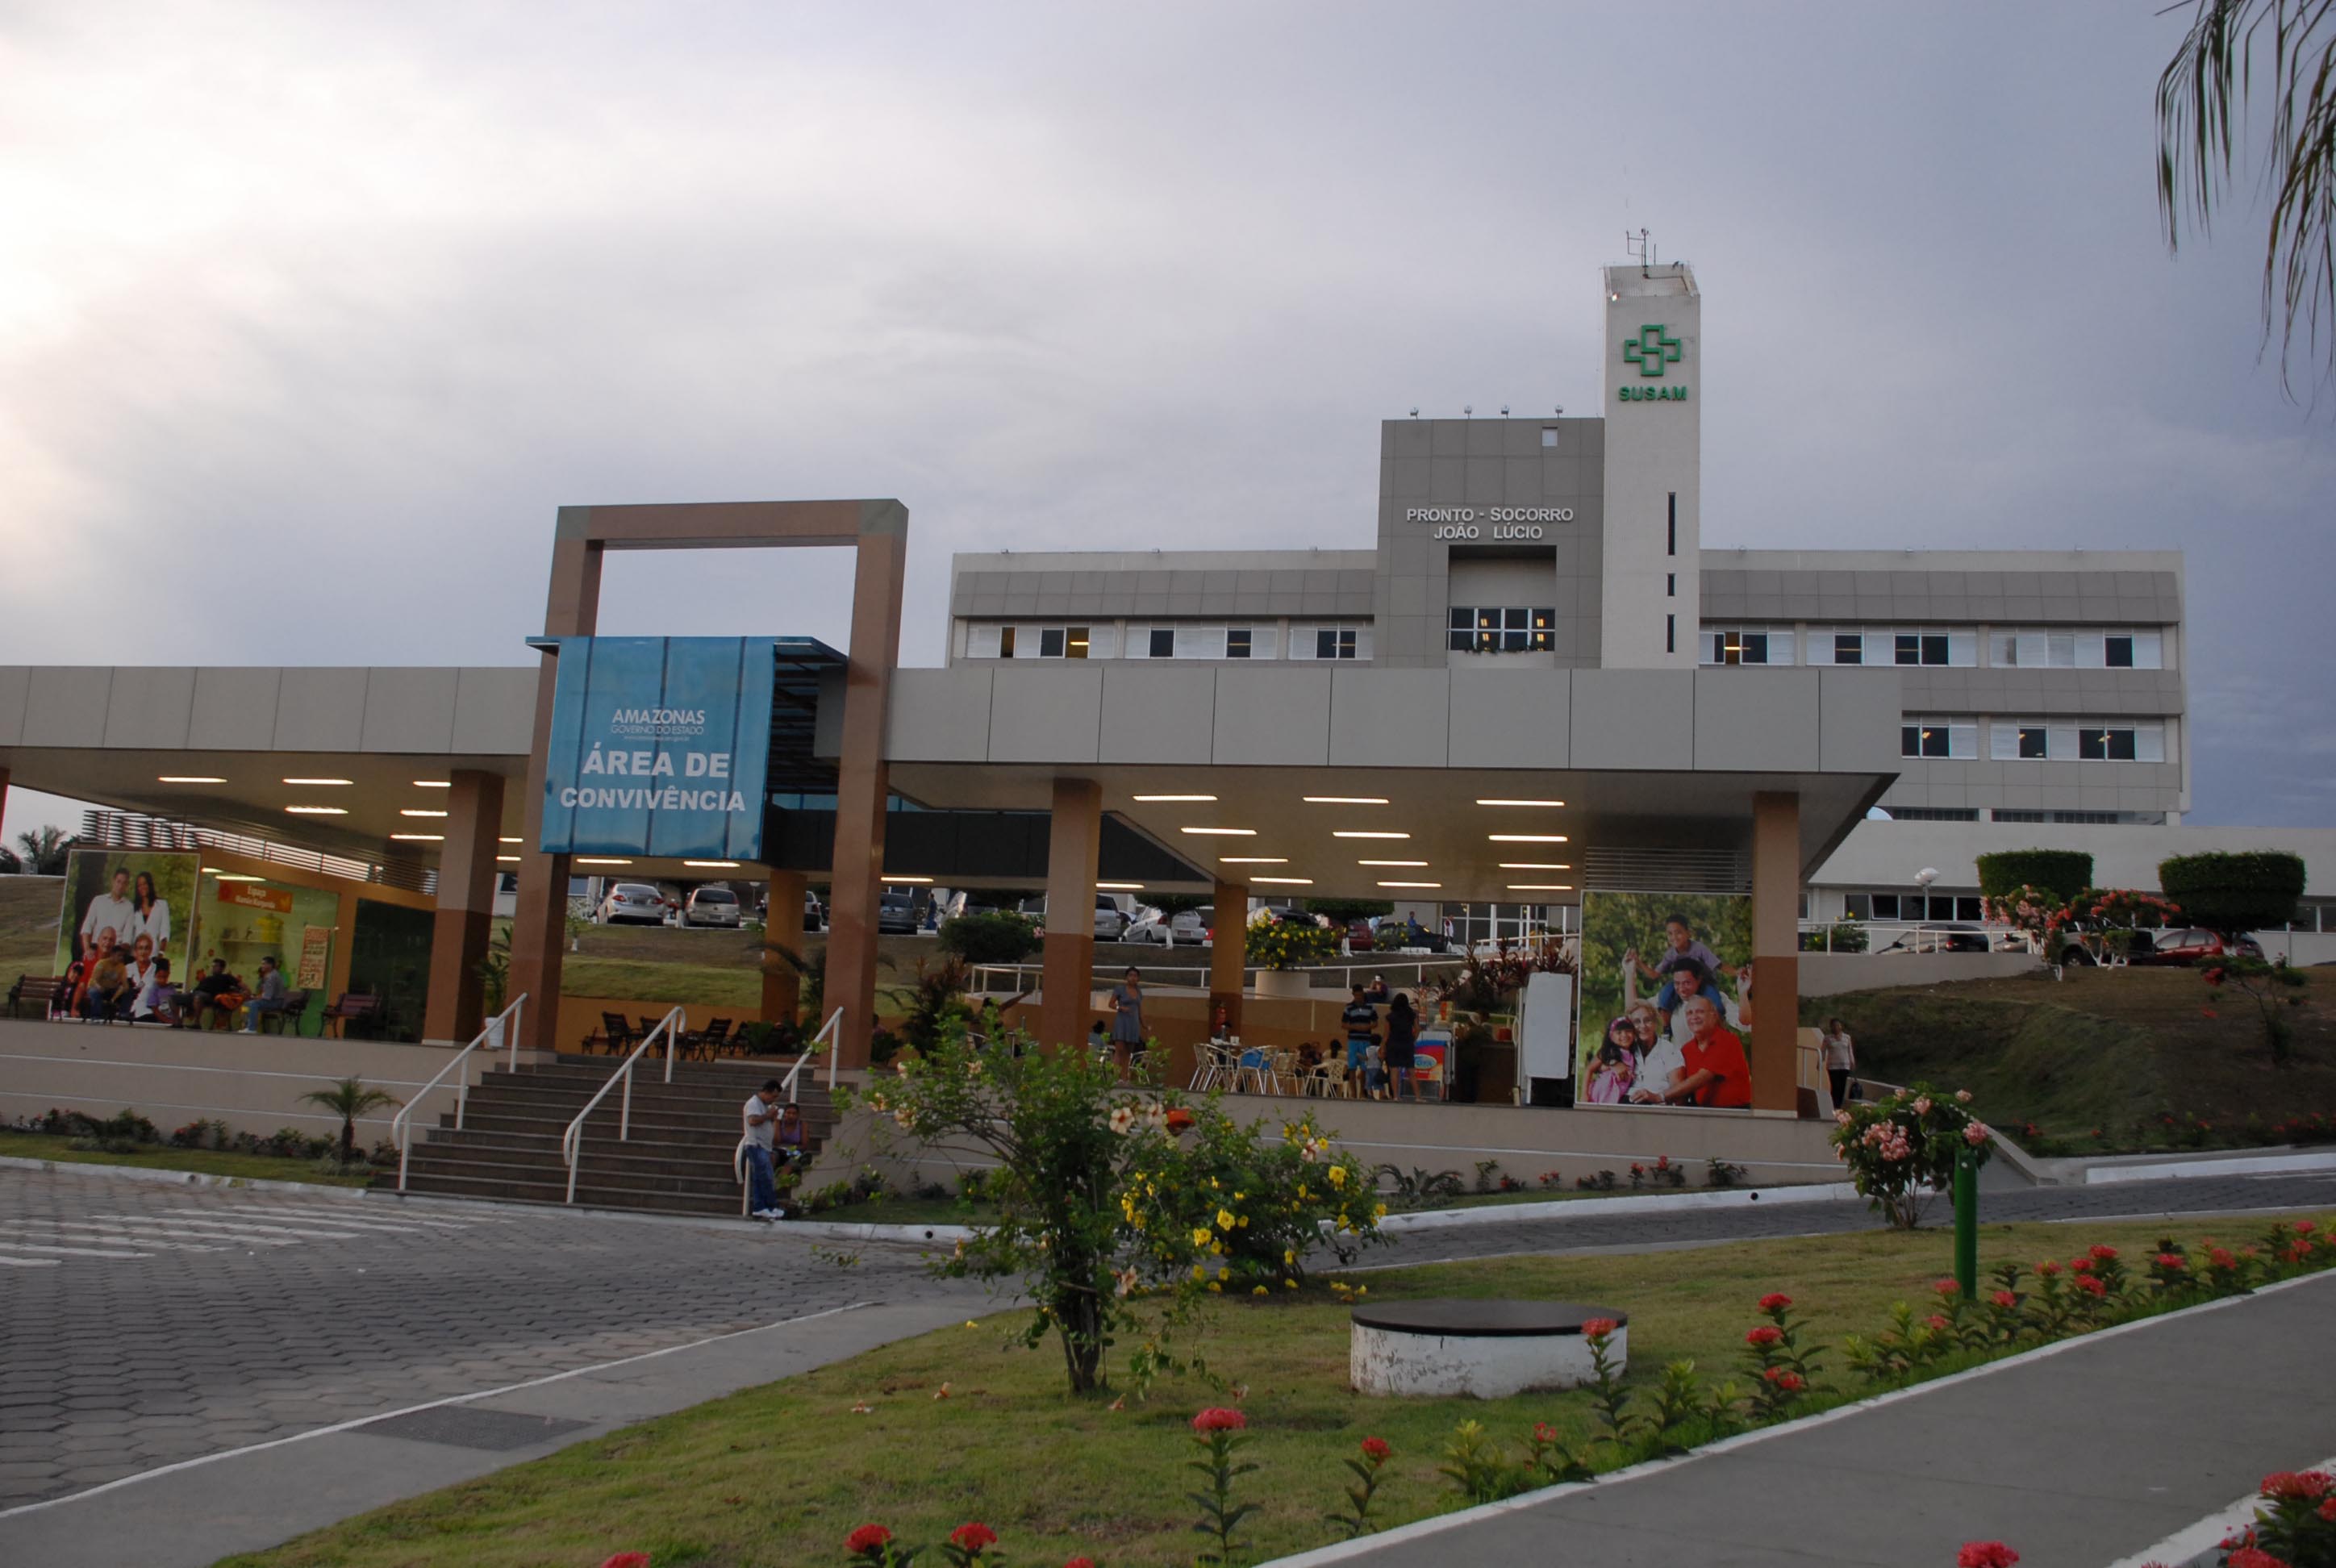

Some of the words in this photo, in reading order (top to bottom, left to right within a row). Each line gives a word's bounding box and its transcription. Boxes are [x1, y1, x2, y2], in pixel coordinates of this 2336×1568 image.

[1619, 386, 1687, 401] SUSAM
[1406, 508, 1475, 522] PRONTO
[1490, 507, 1574, 522] SOCORRO
[1433, 522, 1479, 539] JOÃO
[1493, 521, 1543, 539] LÚCIO
[611, 709, 705, 724] AMAZONAS
[611, 725, 655, 734] GOVERNO
[657, 726, 671, 735] DO
[672, 726, 703, 736] ESTADO
[582, 741, 674, 777] ÁREA
[685, 752, 730, 778] DE
[561, 786, 746, 811] CONVIVÊNCIA
